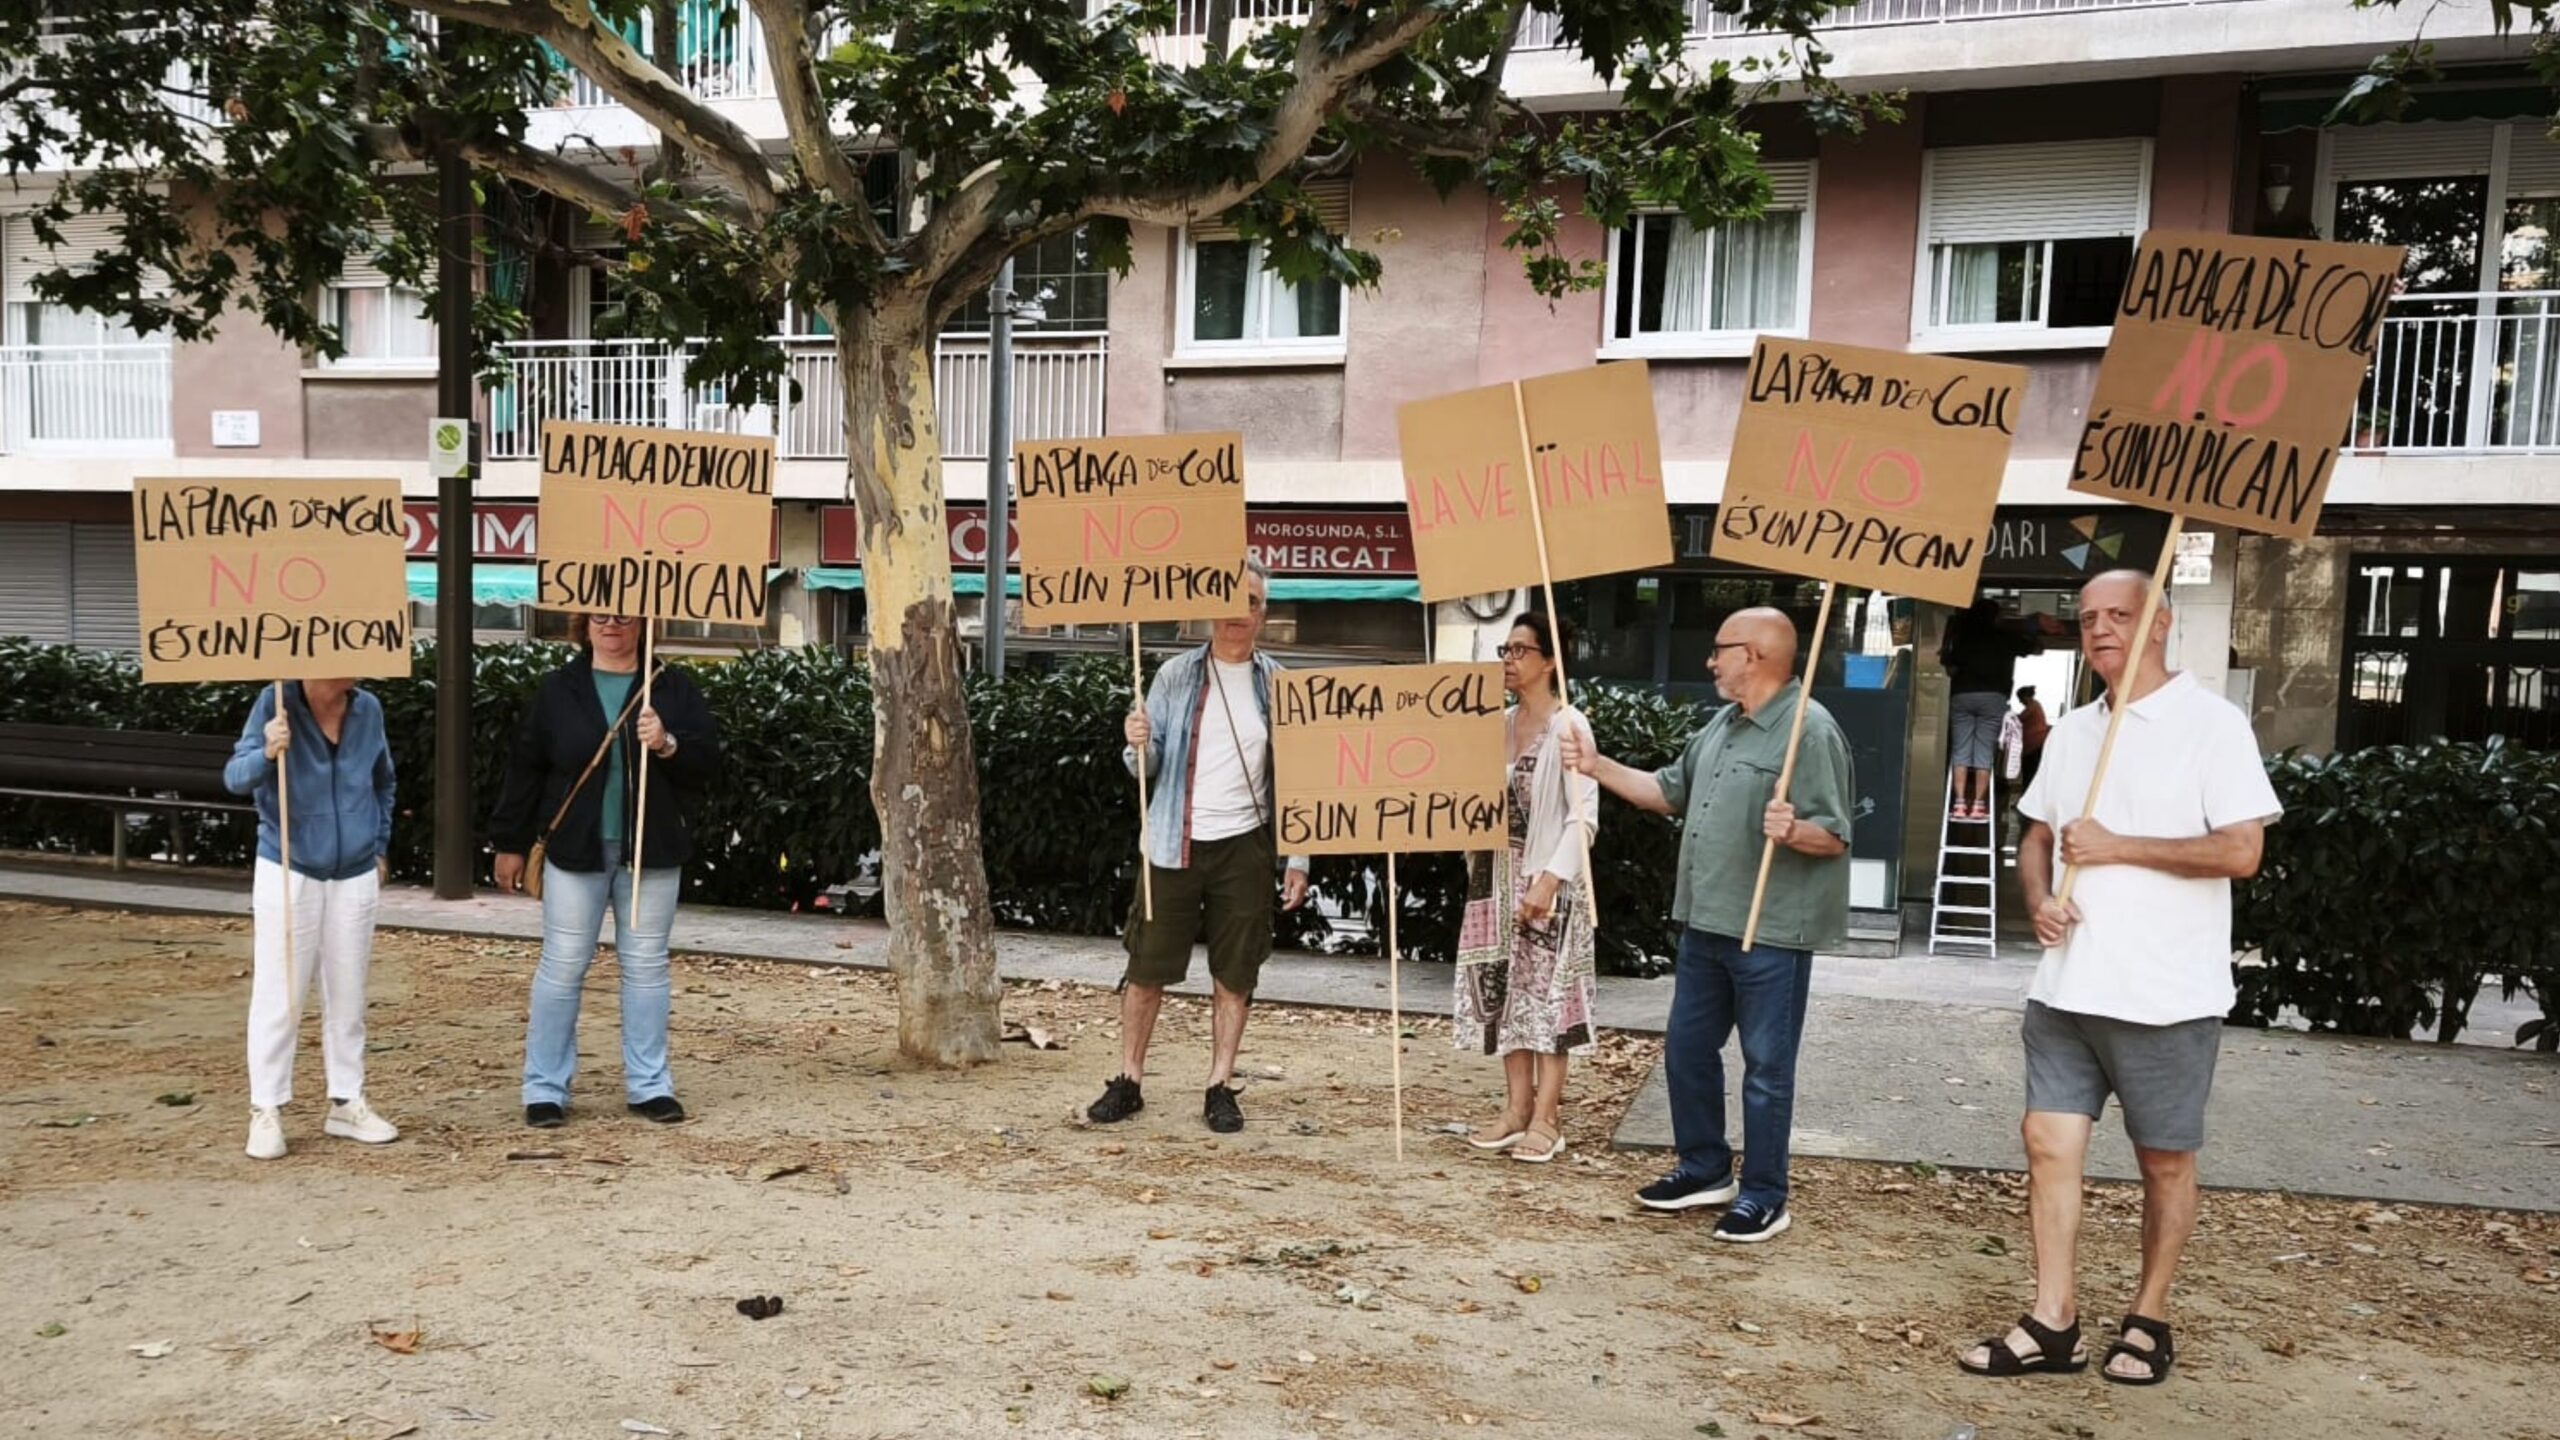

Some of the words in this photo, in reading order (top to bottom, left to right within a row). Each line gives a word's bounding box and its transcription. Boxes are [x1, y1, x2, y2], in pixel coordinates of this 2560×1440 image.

[2151, 329, 2288, 428] NO
[1784, 430, 1924, 511] NO
[604, 493, 711, 551] NO
[1083, 504, 1182, 561] NO
[1255, 523, 1371, 539] NOROSUNDA,
[209, 553, 326, 607] NO
[1337, 730, 1436, 786] NO
